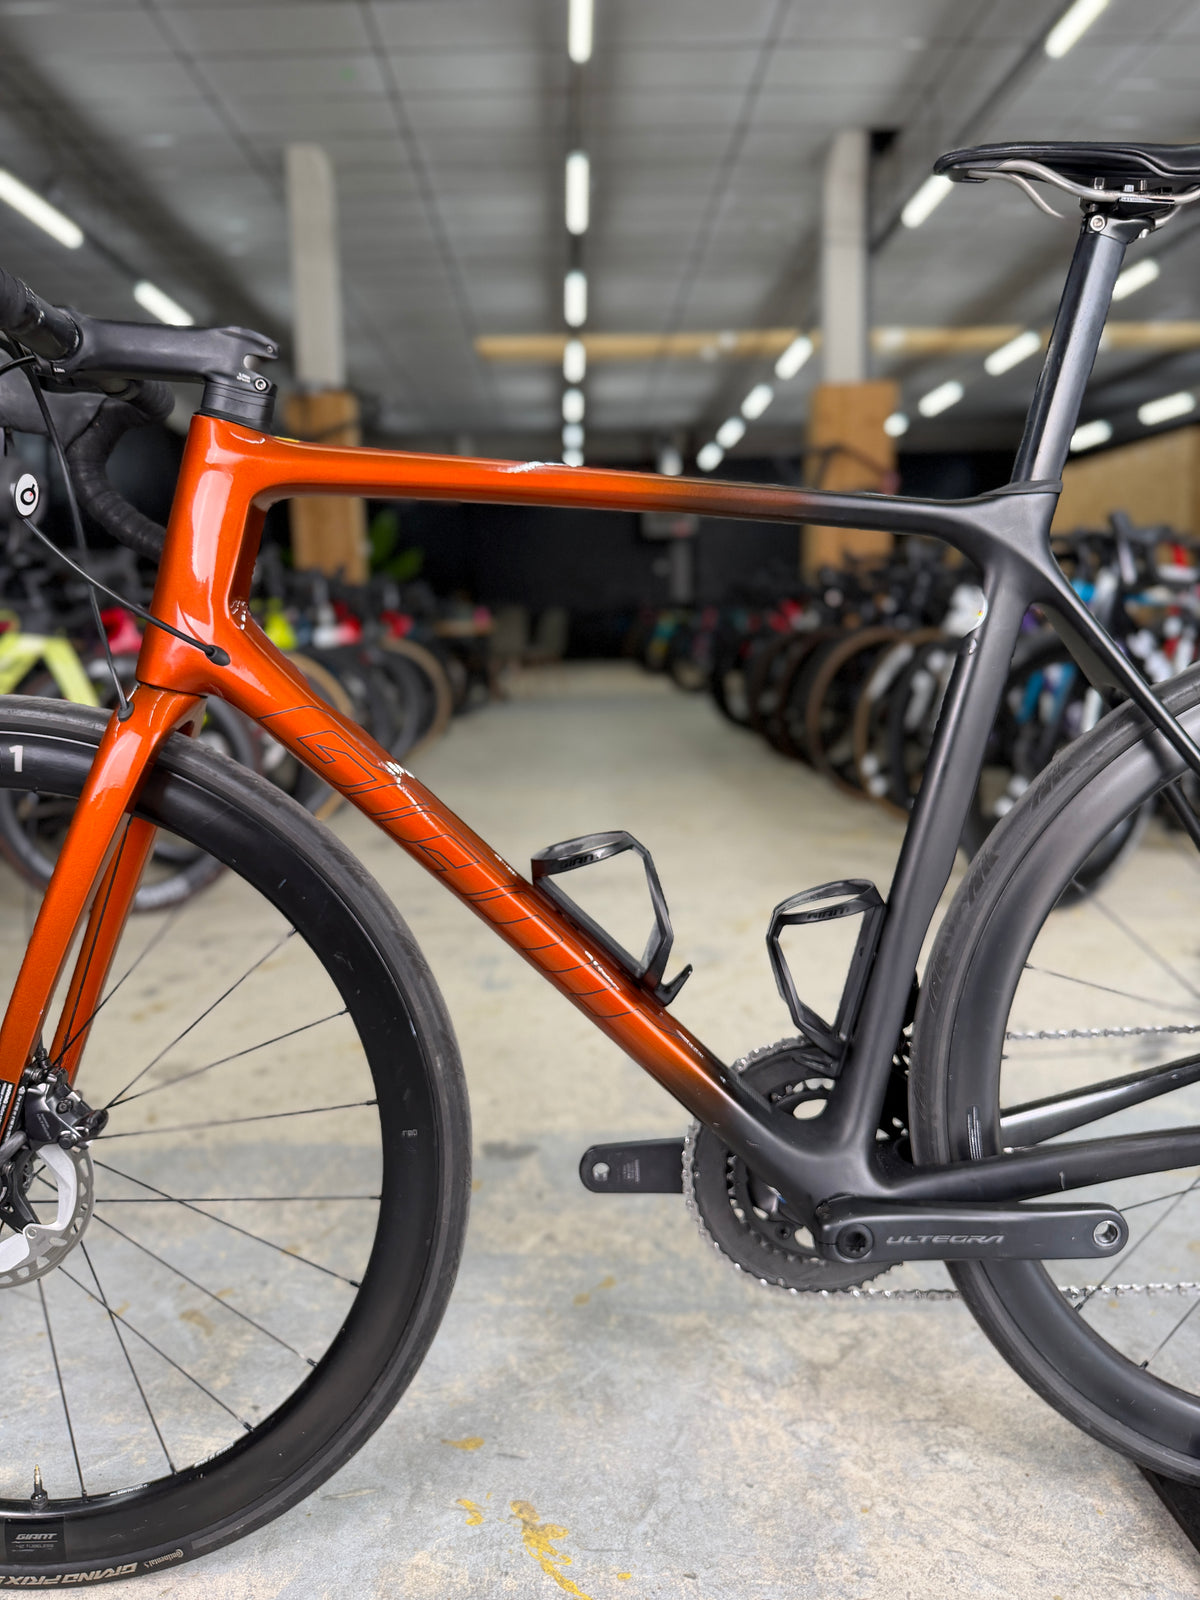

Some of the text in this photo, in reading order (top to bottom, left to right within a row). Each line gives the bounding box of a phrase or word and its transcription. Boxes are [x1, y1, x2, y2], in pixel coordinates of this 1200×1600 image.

[9, 745, 23, 772] 1
[886, 1235, 1004, 1244] ULTEGRA
[149, 1548, 184, 1569] Continental
[3, 1575, 62, 1586] PRIX
[61, 1562, 138, 1583] GRAND
